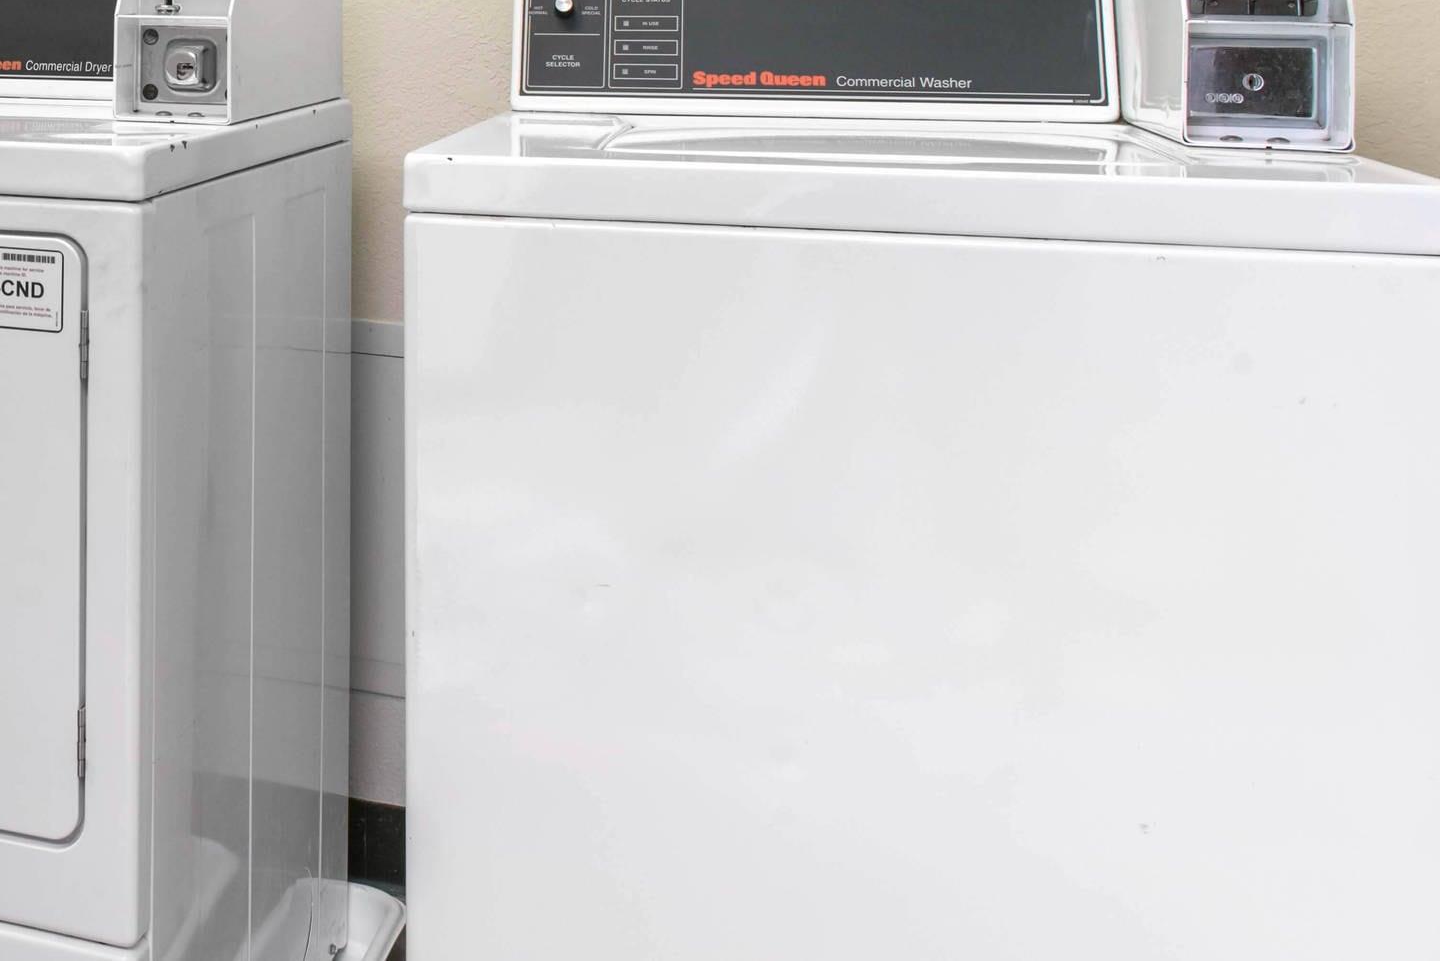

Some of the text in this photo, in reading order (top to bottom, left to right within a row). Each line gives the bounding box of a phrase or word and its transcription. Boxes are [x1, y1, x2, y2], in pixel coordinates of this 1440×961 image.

[25, 59, 83, 72] Commercial
[85, 61, 112, 75] Dryer
[693, 70, 973, 89] Speed Queen Commercial Washer
